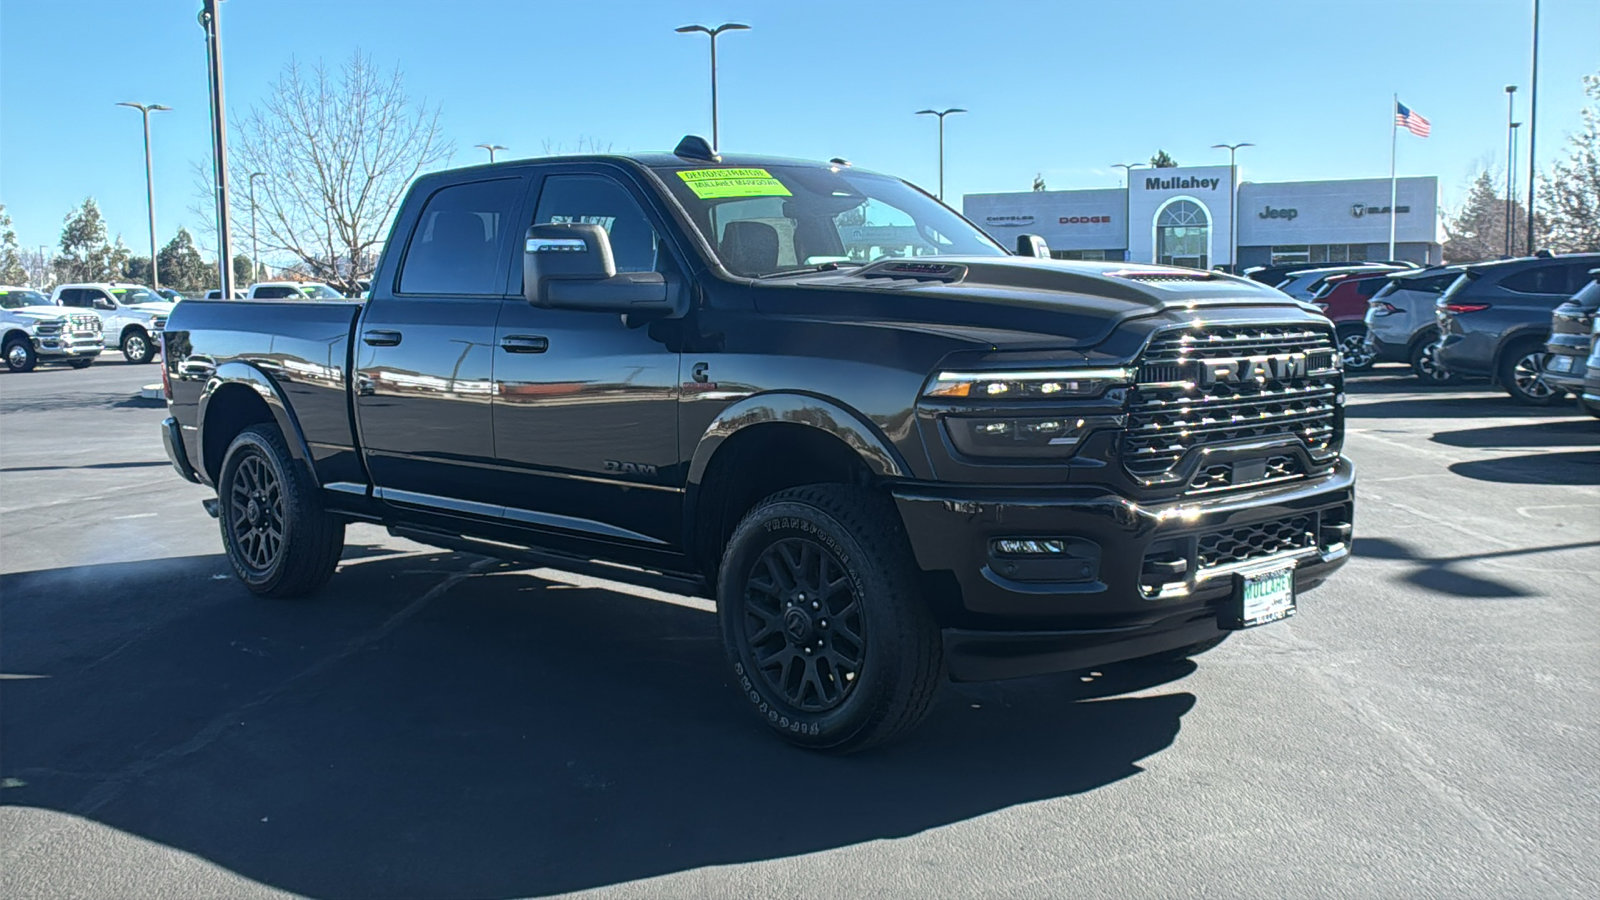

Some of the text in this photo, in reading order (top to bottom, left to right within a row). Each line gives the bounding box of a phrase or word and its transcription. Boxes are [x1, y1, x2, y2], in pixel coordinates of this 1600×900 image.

[1145, 177, 1220, 190] Mullahey
[1058, 216, 1111, 224] DODGE
[1258, 205, 1298, 220] Jeep
[1201, 353, 1306, 383] RAM
[603, 459, 658, 476] RAM
[1244, 575, 1292, 600] MULLAHEY
